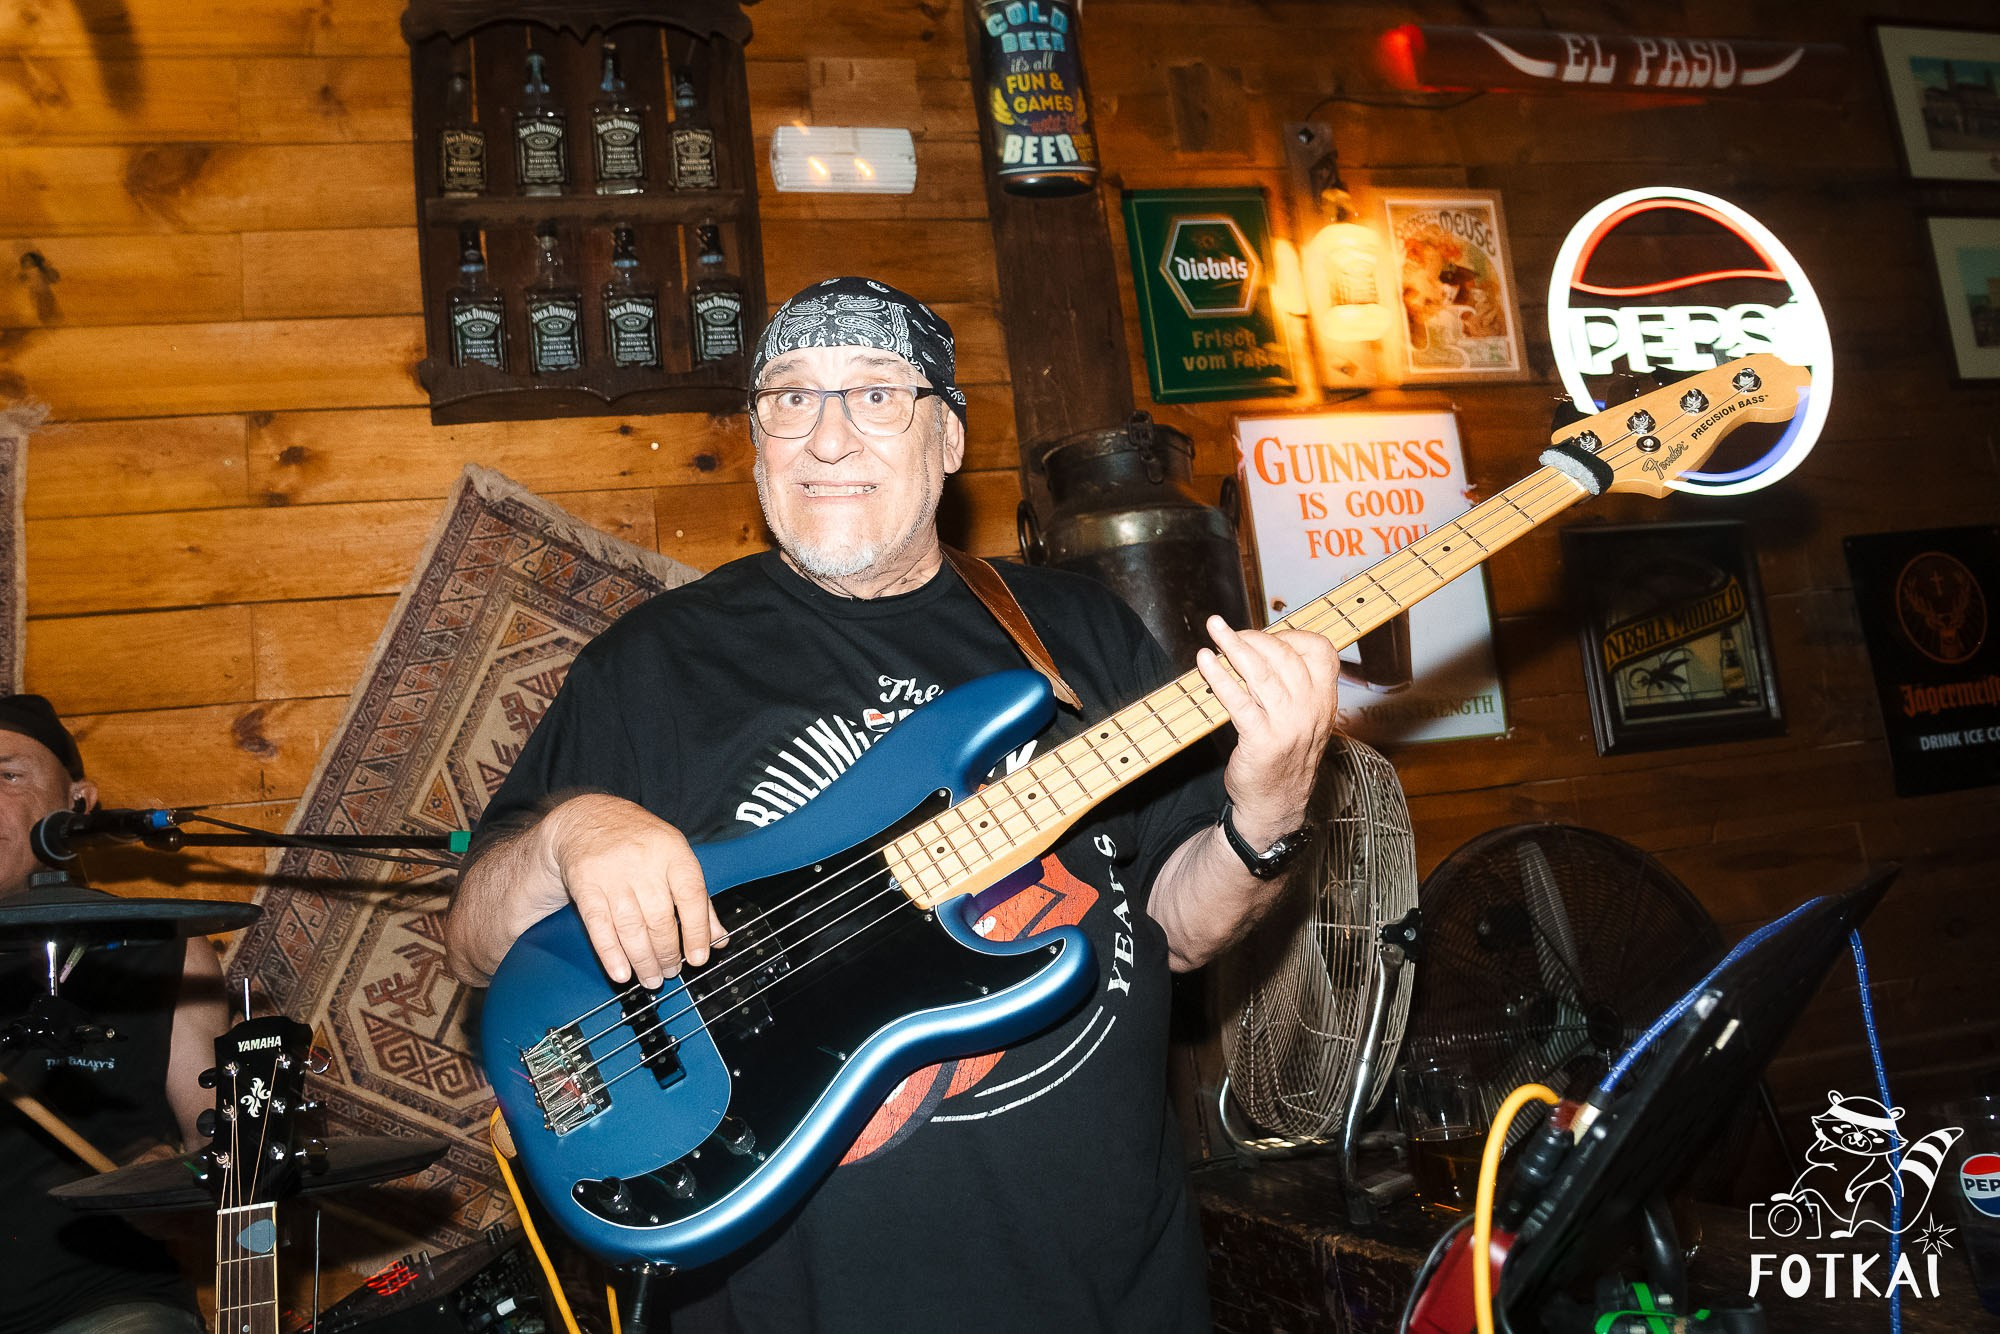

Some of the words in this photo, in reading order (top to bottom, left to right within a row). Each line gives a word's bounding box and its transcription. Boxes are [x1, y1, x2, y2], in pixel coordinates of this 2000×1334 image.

[985, 1, 1068, 37] COLD
[1001, 31, 1066, 53] BEER
[1033, 52, 1054, 71] all
[1557, 32, 1617, 84] EL
[1632, 34, 1737, 89] PASO
[1006, 72, 1045, 94] FUN
[1050, 72, 1064, 92] &
[1013, 95, 1074, 114] GAMES
[1003, 134, 1078, 164] BEER
[1440, 211, 1495, 256] MEUSE
[1191, 327, 1257, 349] Frisch
[1569, 303, 1812, 374] PEPS
[1183, 355, 1227, 371] vom
[1642, 441, 1689, 480] Fender
[1691, 404, 1736, 440] PRECISION
[1254, 436, 1452, 485] GUINNESS
[1297, 492, 1328, 520] IS
[1346, 488, 1424, 518] GOOD
[1306, 528, 1367, 560] FOR
[878, 674, 944, 705] The
[1404, 694, 1495, 722] TRENGTH
[1920, 731, 1962, 751] DRINK
[1963, 728, 1986, 745] ICE
[237, 1035, 282, 1053] YAMAHA
